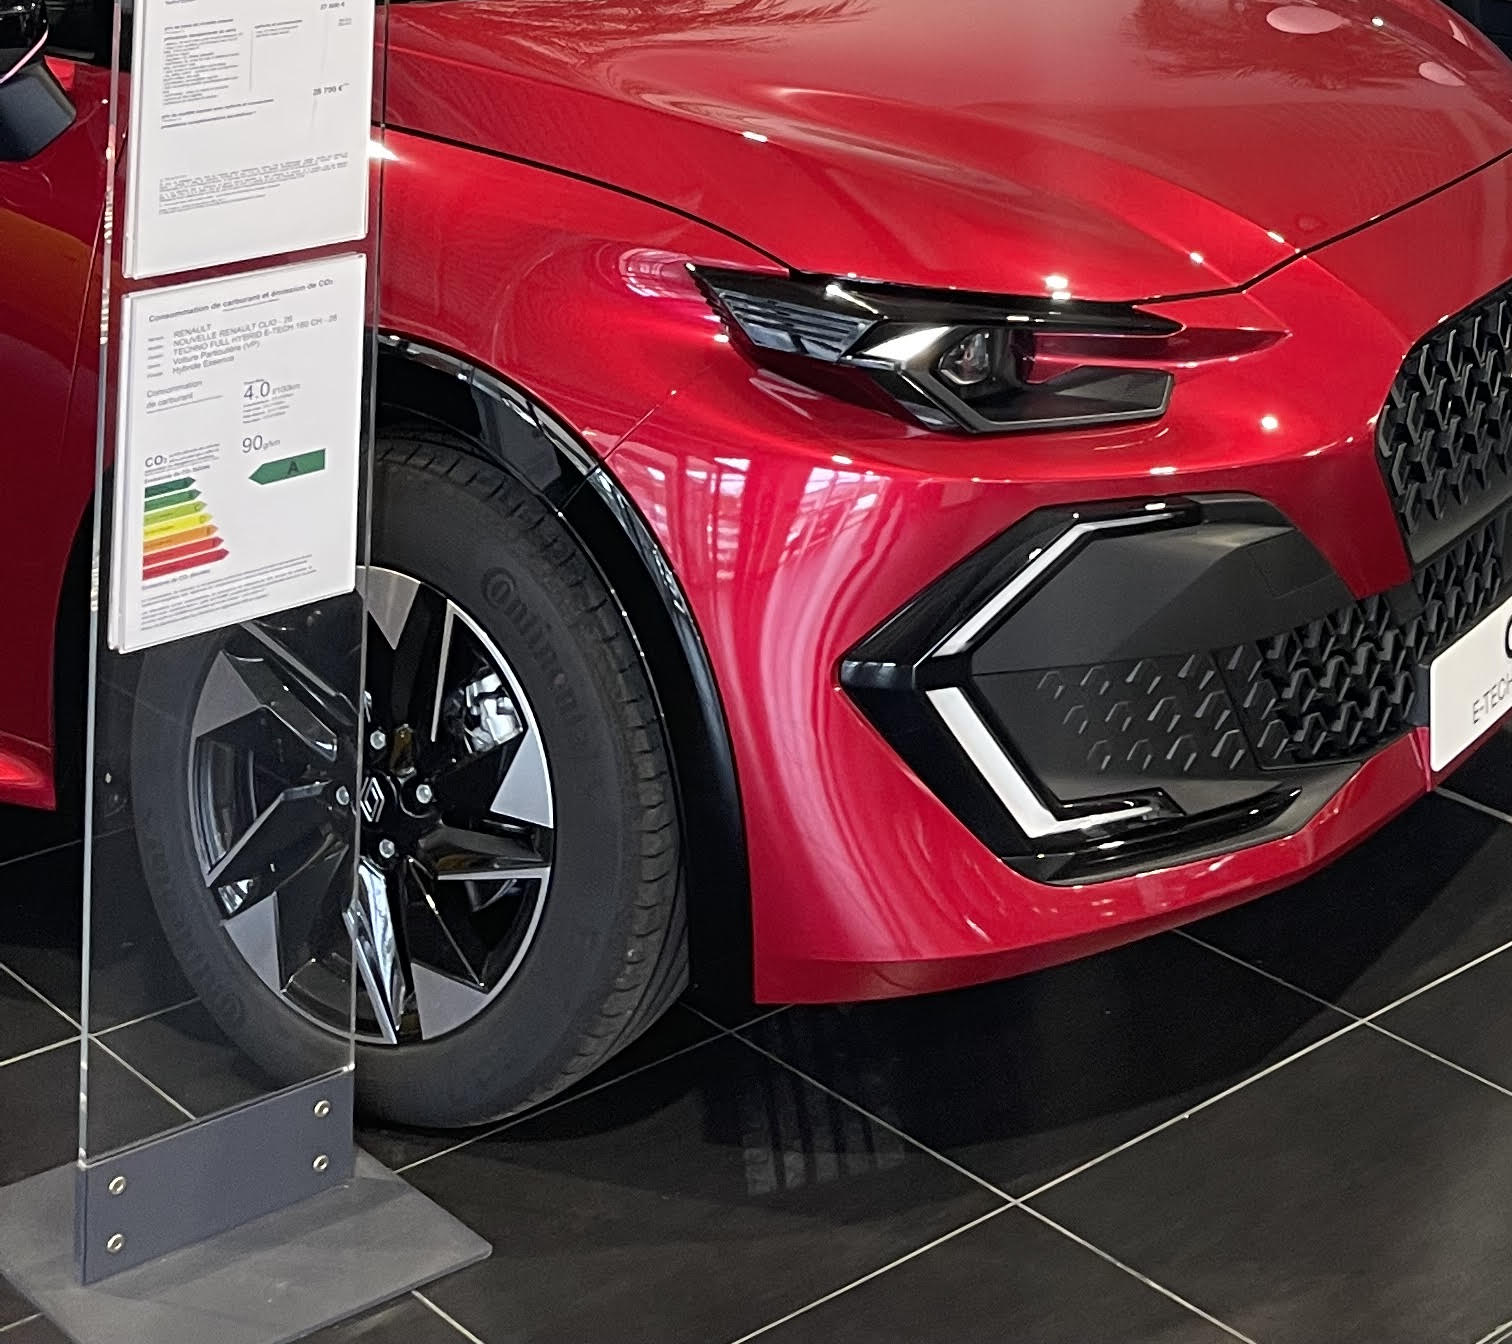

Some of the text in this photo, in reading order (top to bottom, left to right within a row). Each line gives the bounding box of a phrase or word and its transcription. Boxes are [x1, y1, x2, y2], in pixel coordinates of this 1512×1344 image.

[173, 323, 212, 338] RENAULT
[173, 331, 217, 346] NOUVELLE
[219, 323, 257, 337] RENAULT
[210, 338, 230, 350] FULL
[243, 381, 271, 401] 4.0
[242, 435, 263, 453] 90
[287, 461, 300, 475] A
